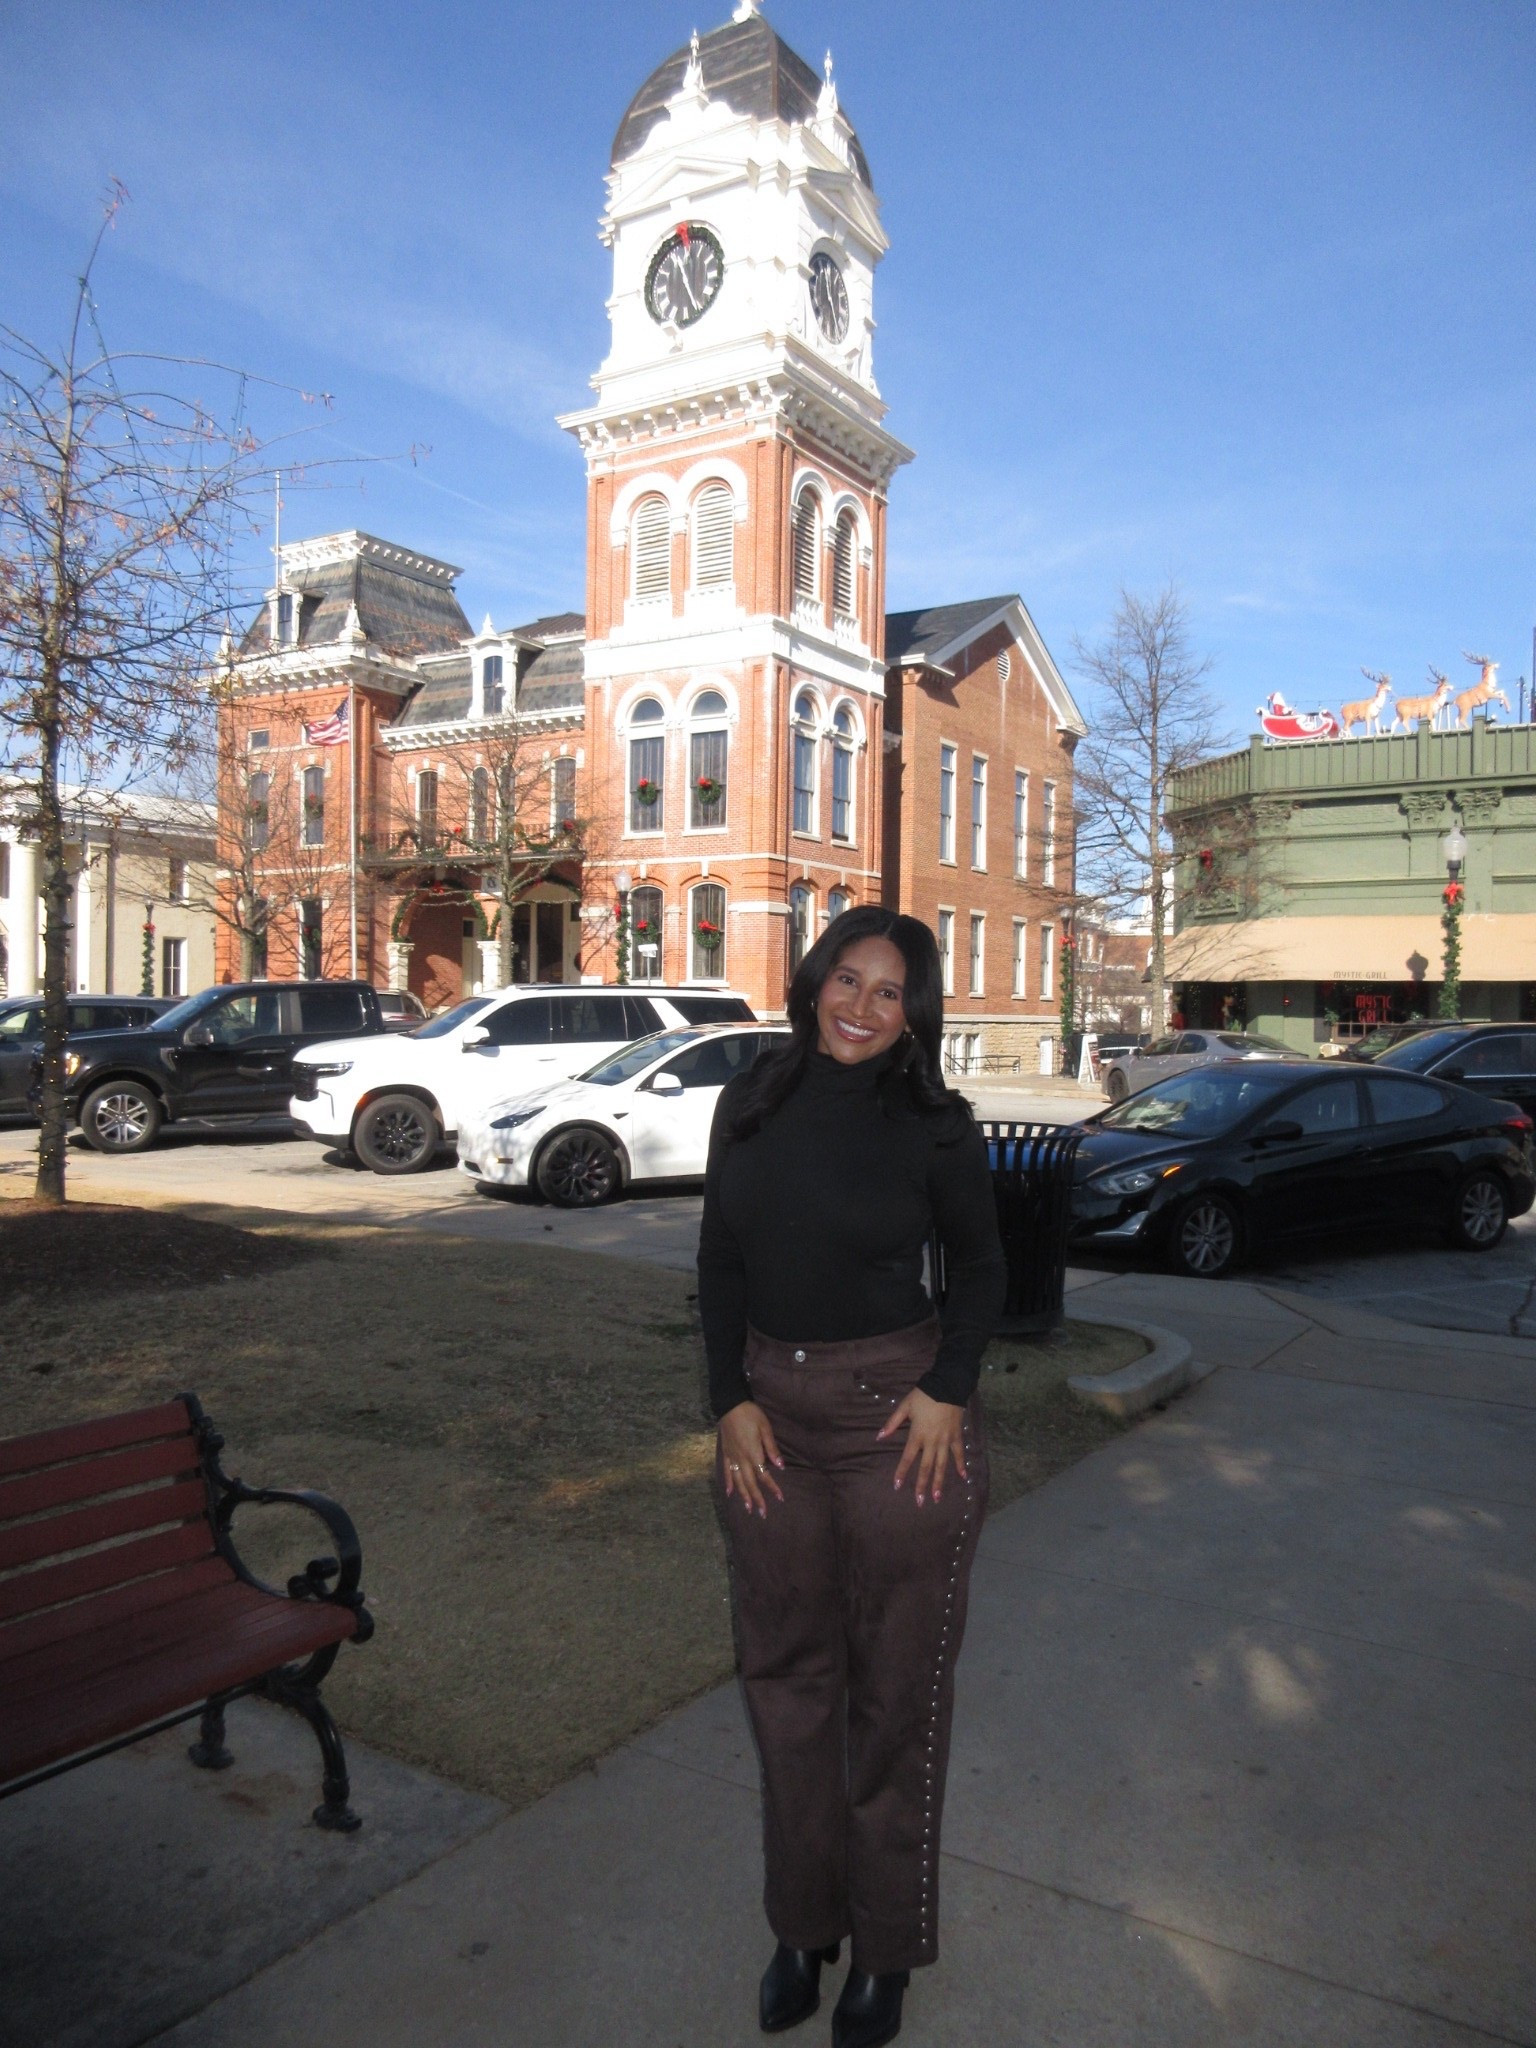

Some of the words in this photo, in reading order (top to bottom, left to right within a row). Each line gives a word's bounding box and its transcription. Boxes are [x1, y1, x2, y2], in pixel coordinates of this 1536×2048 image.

[1333, 971, 1362, 979] MYSTIC
[1365, 971, 1387, 979] GRILL
[1358, 1009, 1391, 1024] GRIL
